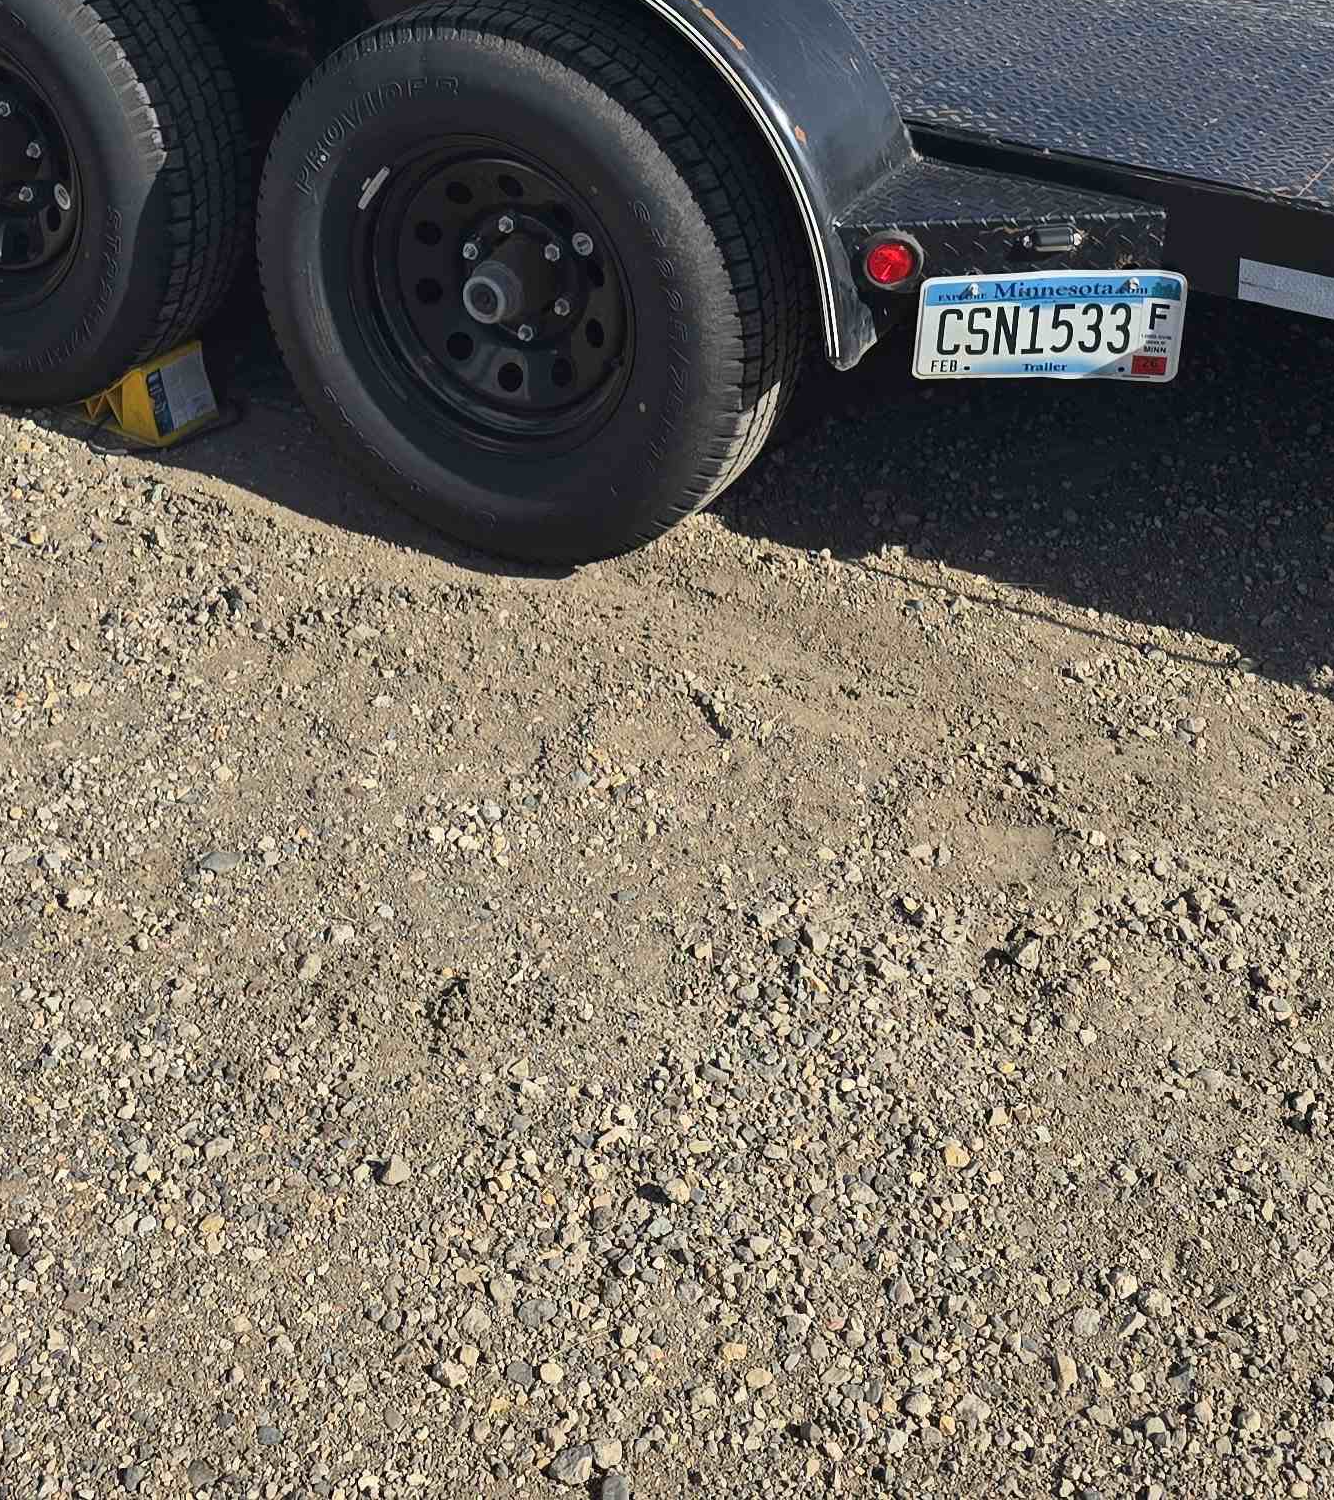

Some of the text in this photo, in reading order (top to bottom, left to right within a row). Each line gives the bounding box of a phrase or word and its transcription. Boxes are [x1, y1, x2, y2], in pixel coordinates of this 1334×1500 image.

[296, 76, 459, 195] PROVIDER
[937, 303, 1132, 355] CSN1533
[1149, 303, 1170, 330] F
[930, 359, 958, 373] FEB
[1022, 361, 1068, 373] Trailer
